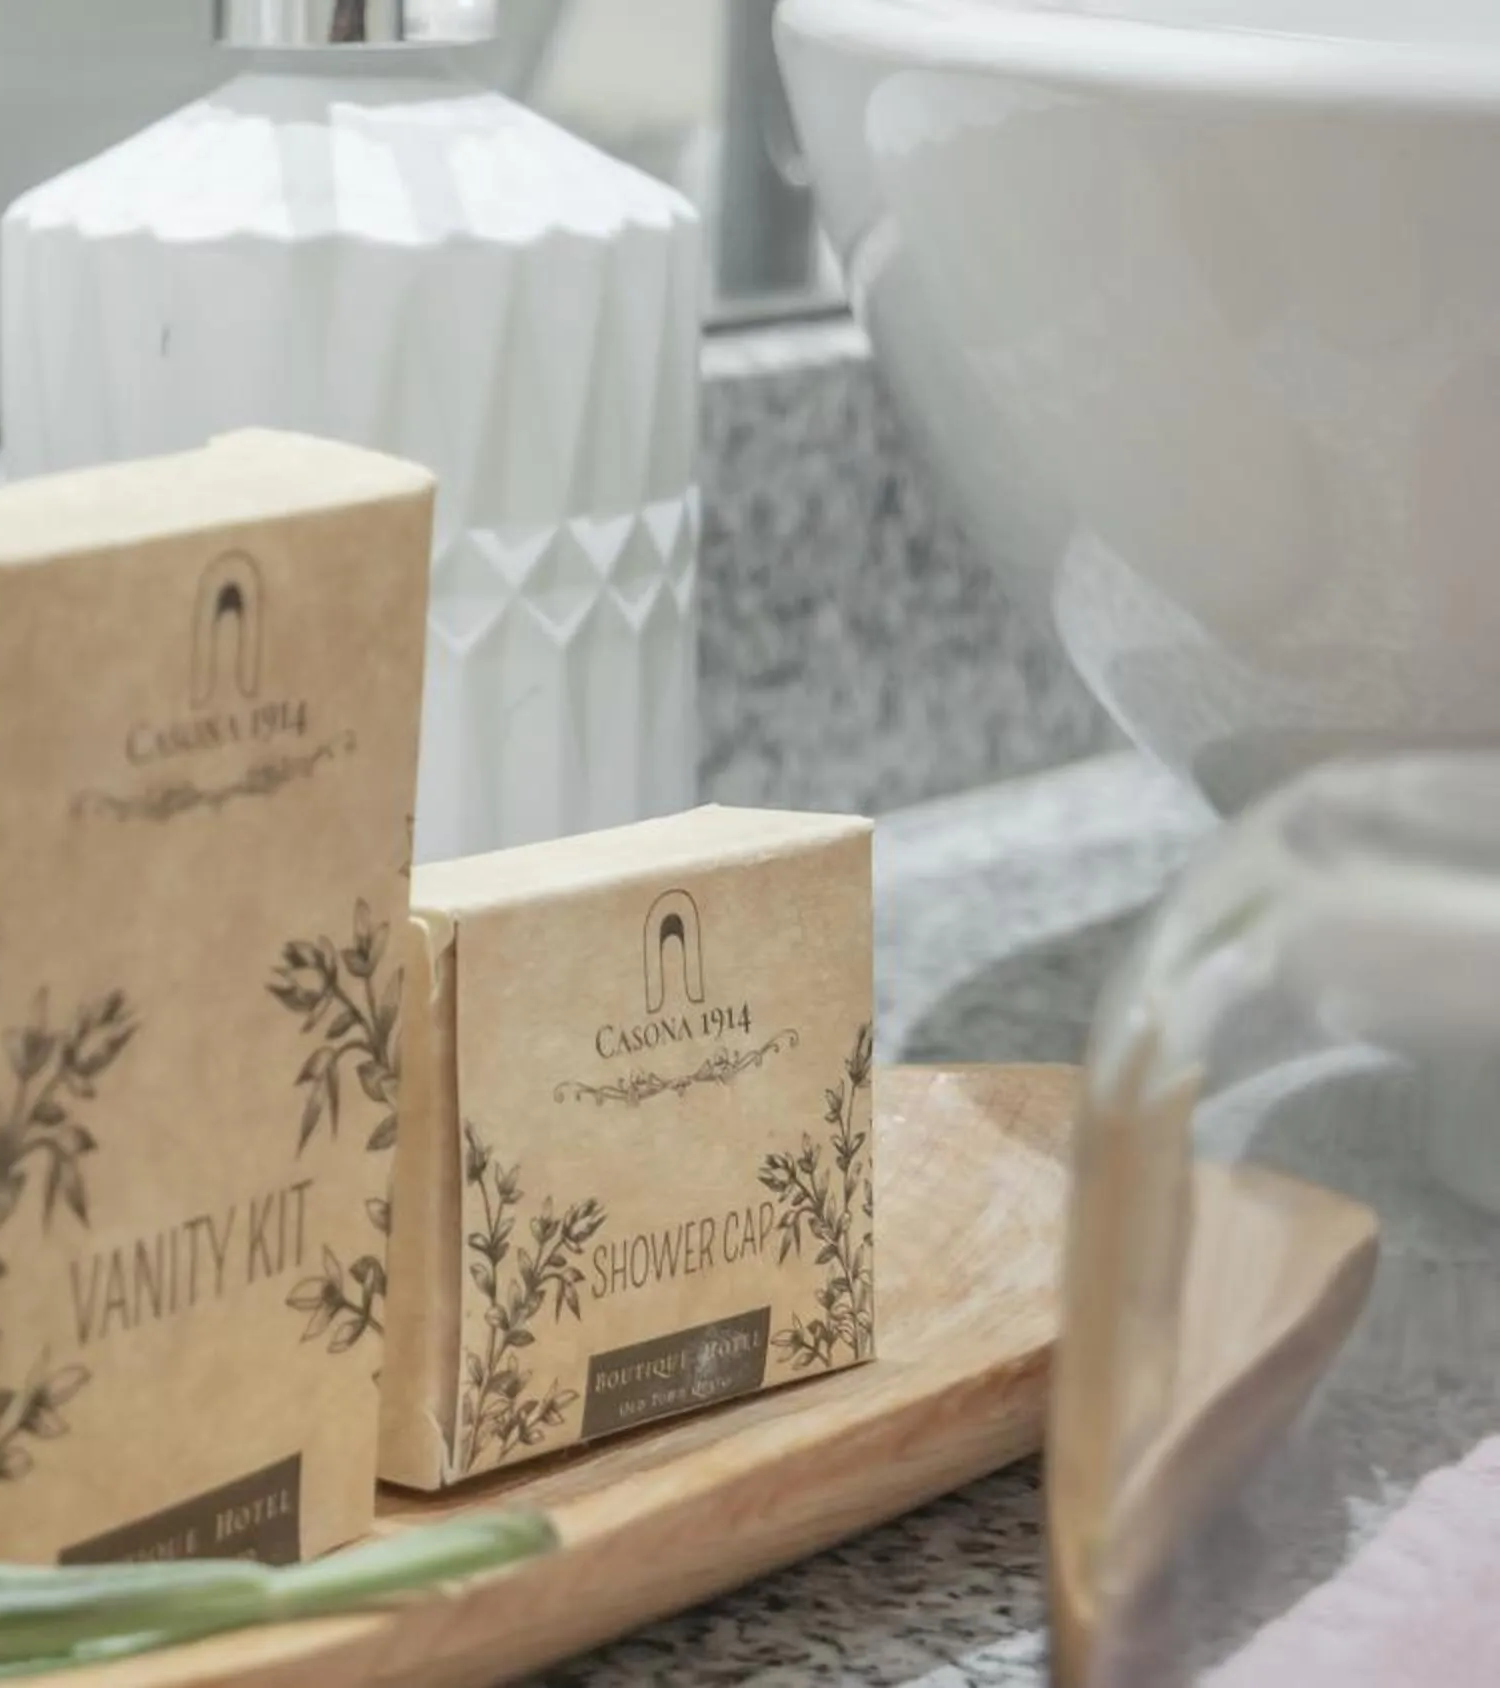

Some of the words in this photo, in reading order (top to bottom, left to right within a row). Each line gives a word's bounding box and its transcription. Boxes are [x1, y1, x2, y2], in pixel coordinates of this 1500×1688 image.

[250, 700, 307, 742] 1914
[595, 1018, 692, 1059] CASONA
[700, 1001, 752, 1037] 1914
[70, 1205, 236, 1347] VANITY
[249, 1179, 313, 1284] KIT
[592, 1217, 716, 1299] SHOWER
[723, 1202, 774, 1263] CAP
[595, 1352, 688, 1393] BOUTIQUE
[215, 1488, 291, 1542] HOTEL
